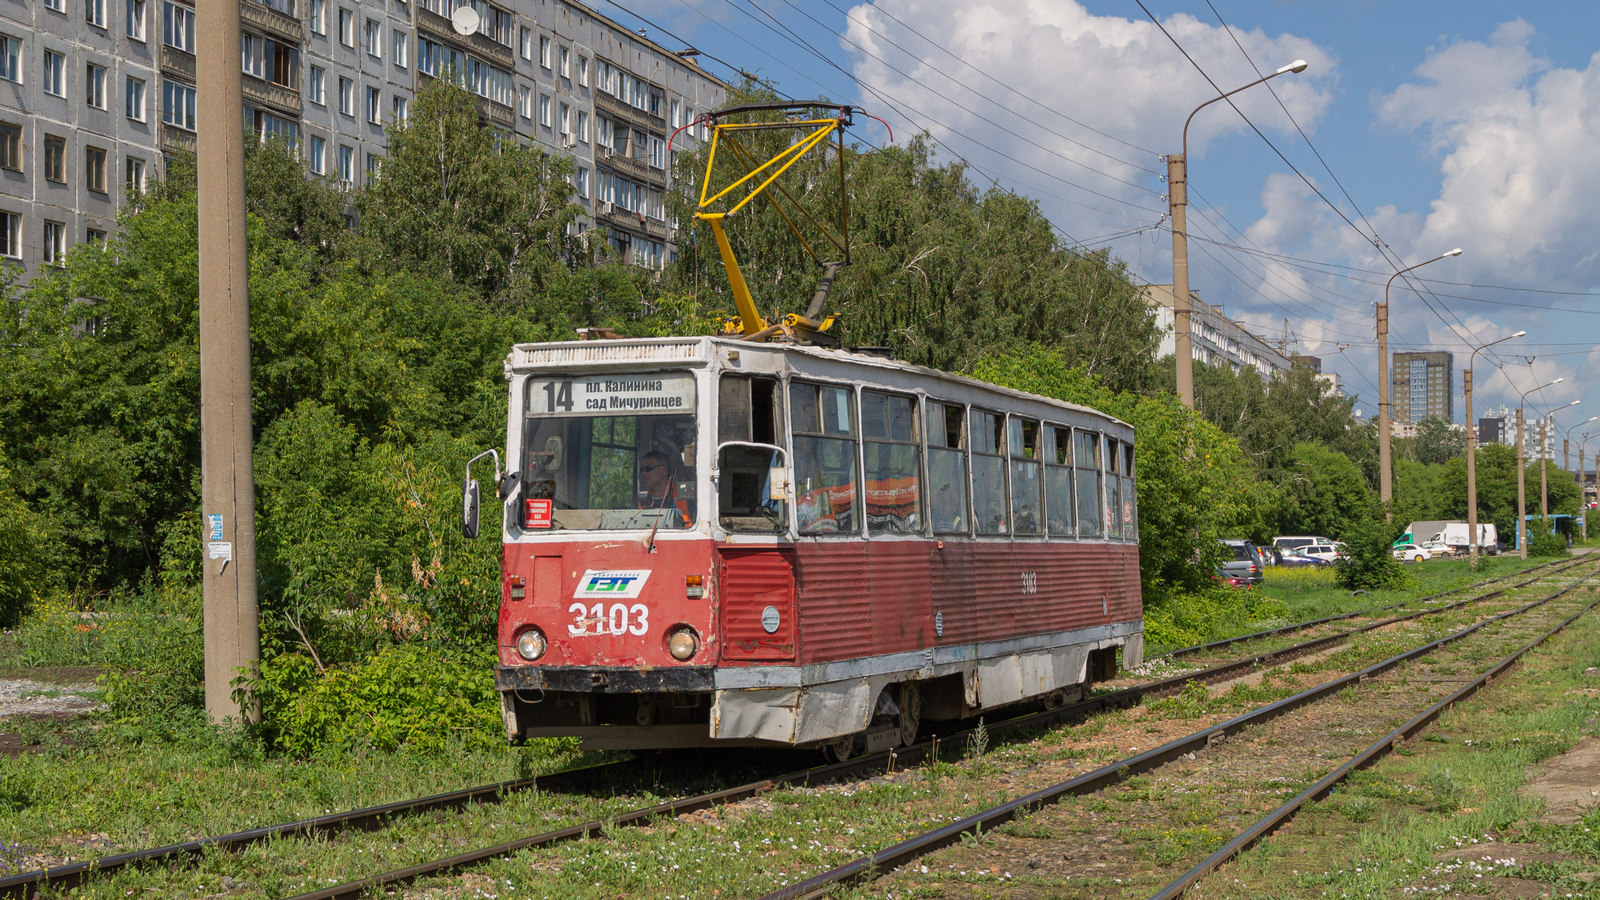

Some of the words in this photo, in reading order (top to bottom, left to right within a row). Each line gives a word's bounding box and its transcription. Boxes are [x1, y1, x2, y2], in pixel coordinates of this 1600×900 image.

[542, 380, 574, 412] 14
[585, 381, 603, 393] пл.
[605, 380, 663, 393] Калинина
[585, 398, 607, 410] сад
[609, 395, 683, 410] Мичуринцев
[1021, 571, 1037, 595] 3103
[567, 602, 649, 637] 3103
